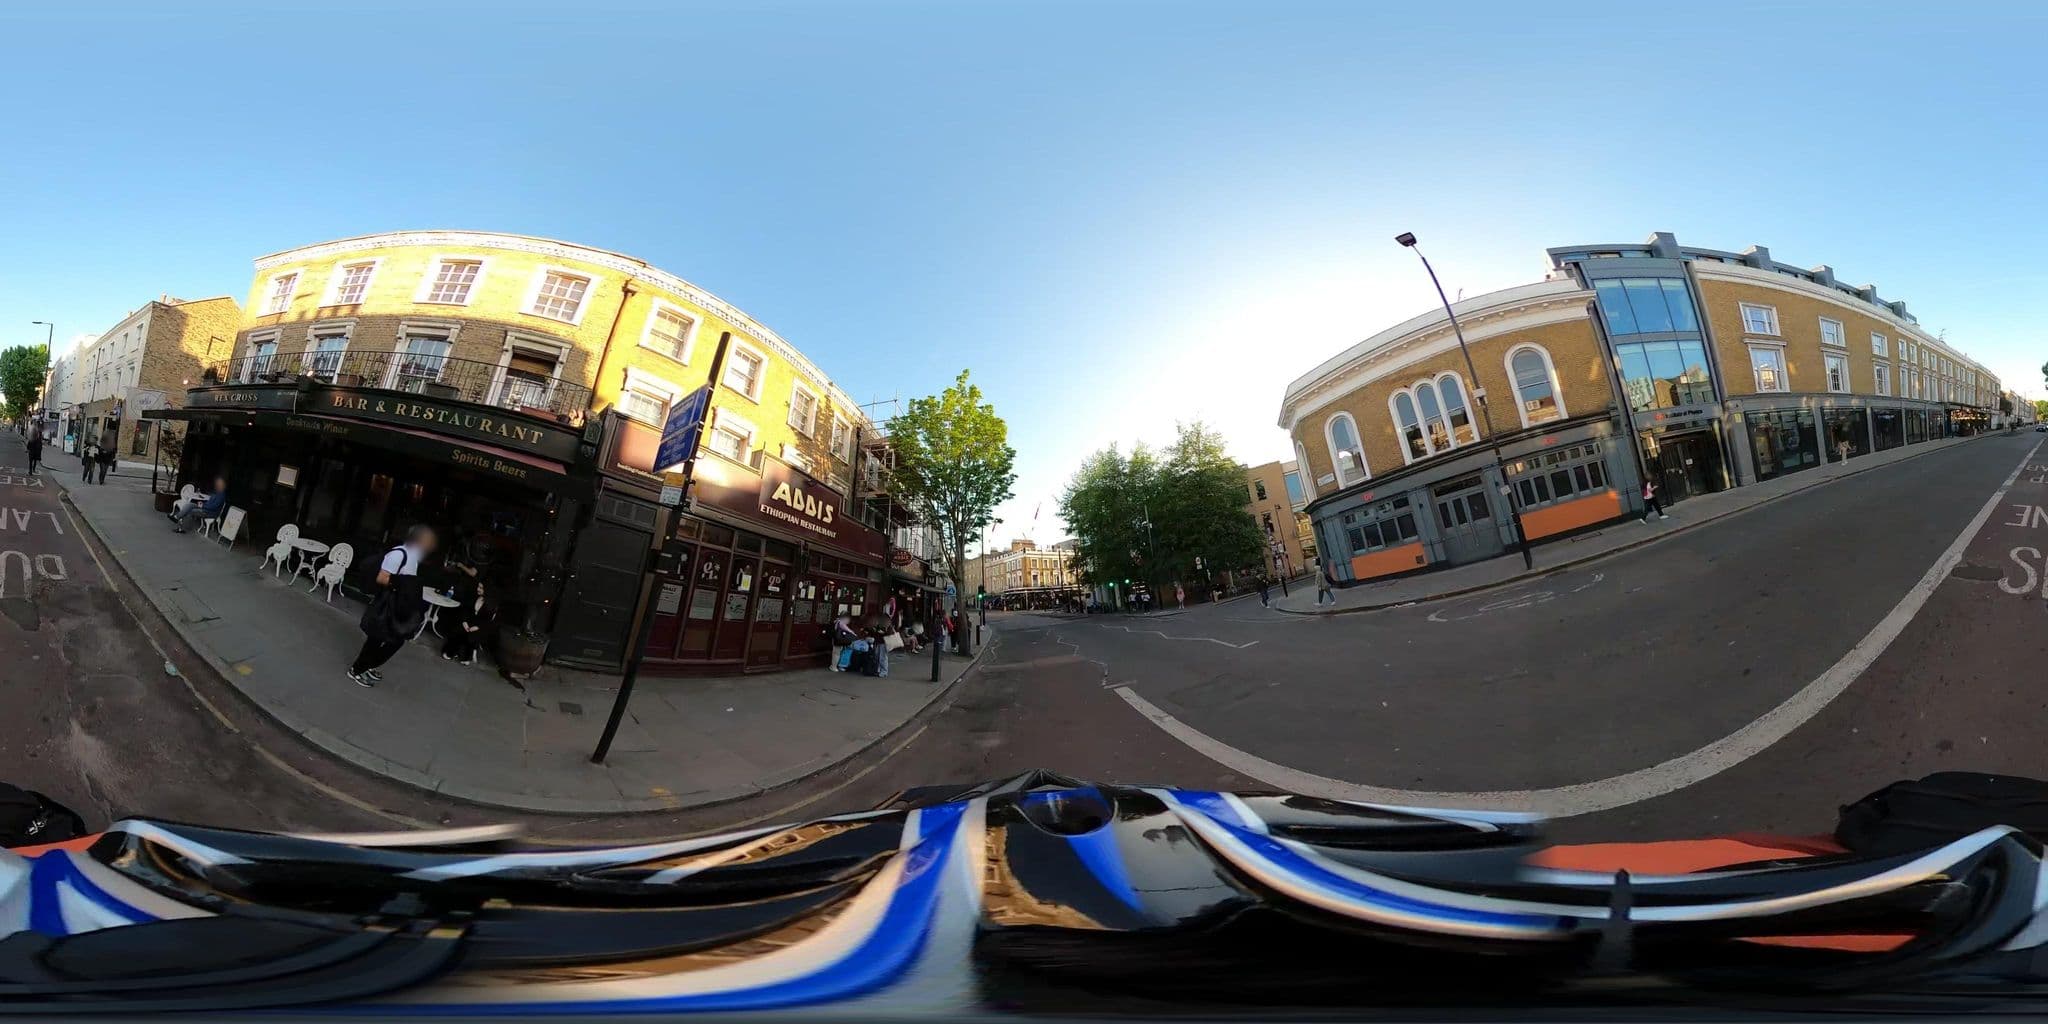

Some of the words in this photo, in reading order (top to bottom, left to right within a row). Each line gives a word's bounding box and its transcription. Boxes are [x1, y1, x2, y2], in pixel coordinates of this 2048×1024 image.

[231, 393, 258, 401] CROSS
[334, 396, 367, 410] BAR
[376, 400, 386, 412] &
[395, 403, 543, 444] RESTAURANT
[452, 449, 489, 468] Spirits
[494, 460, 527, 479] Beers
[772, 481, 834, 524] ADDIS
[760, 504, 799, 525] ETHIOPIAN
[800, 519, 838, 538] RESTAURANT
